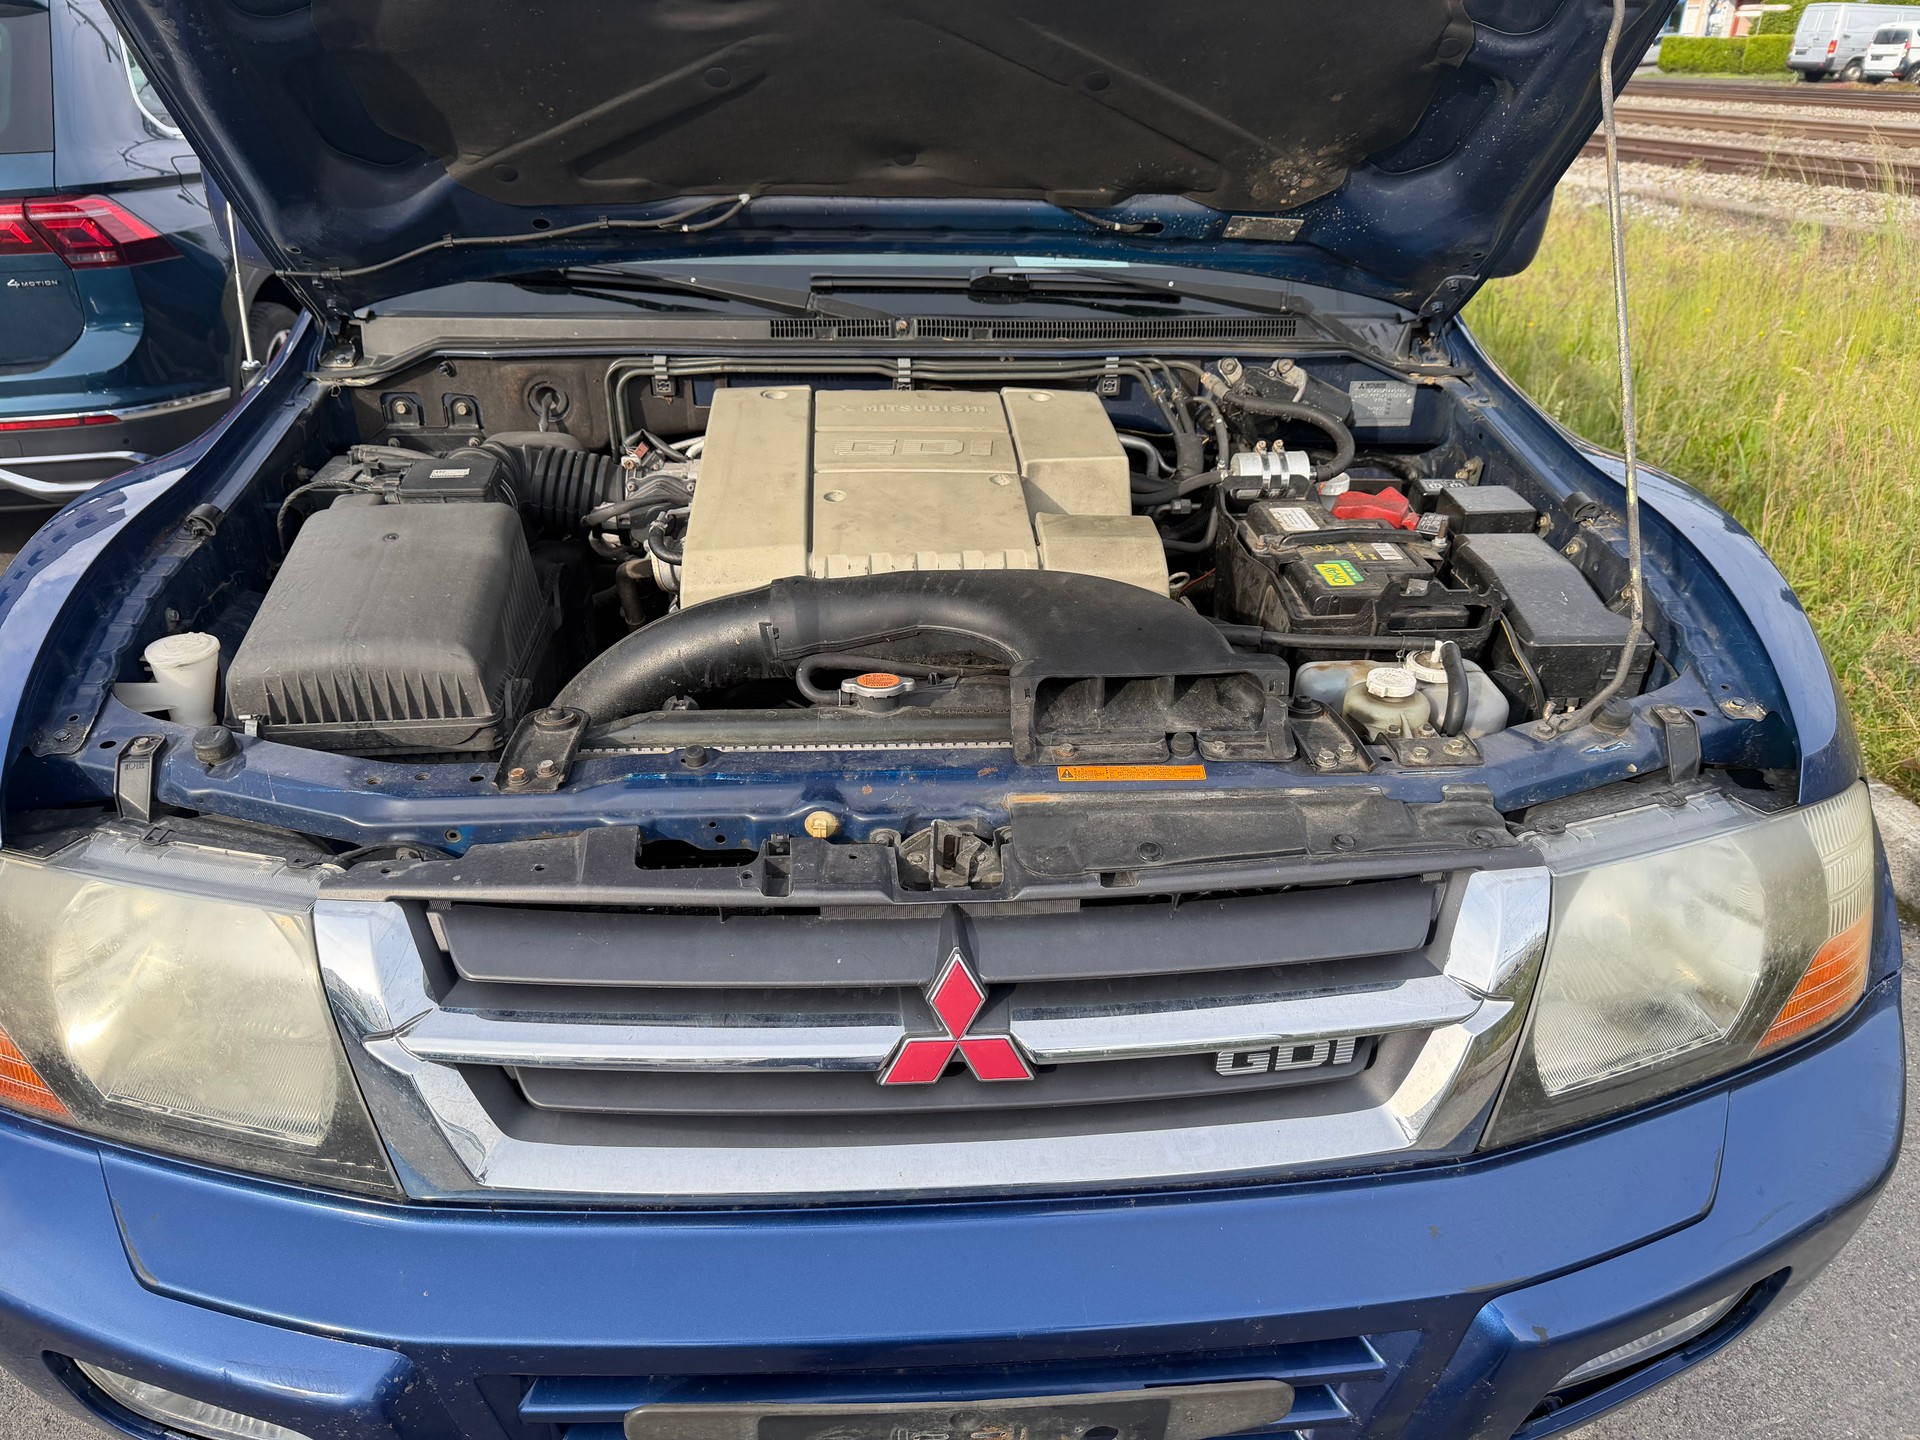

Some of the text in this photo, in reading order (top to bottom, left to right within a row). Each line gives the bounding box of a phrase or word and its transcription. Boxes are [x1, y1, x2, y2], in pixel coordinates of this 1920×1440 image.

[7, 279, 58, 288] 4MOTION
[863, 404, 987, 413] MITSUBISHI
[834, 439, 993, 456] GDI
[1216, 1038, 1356, 1076] GDI
